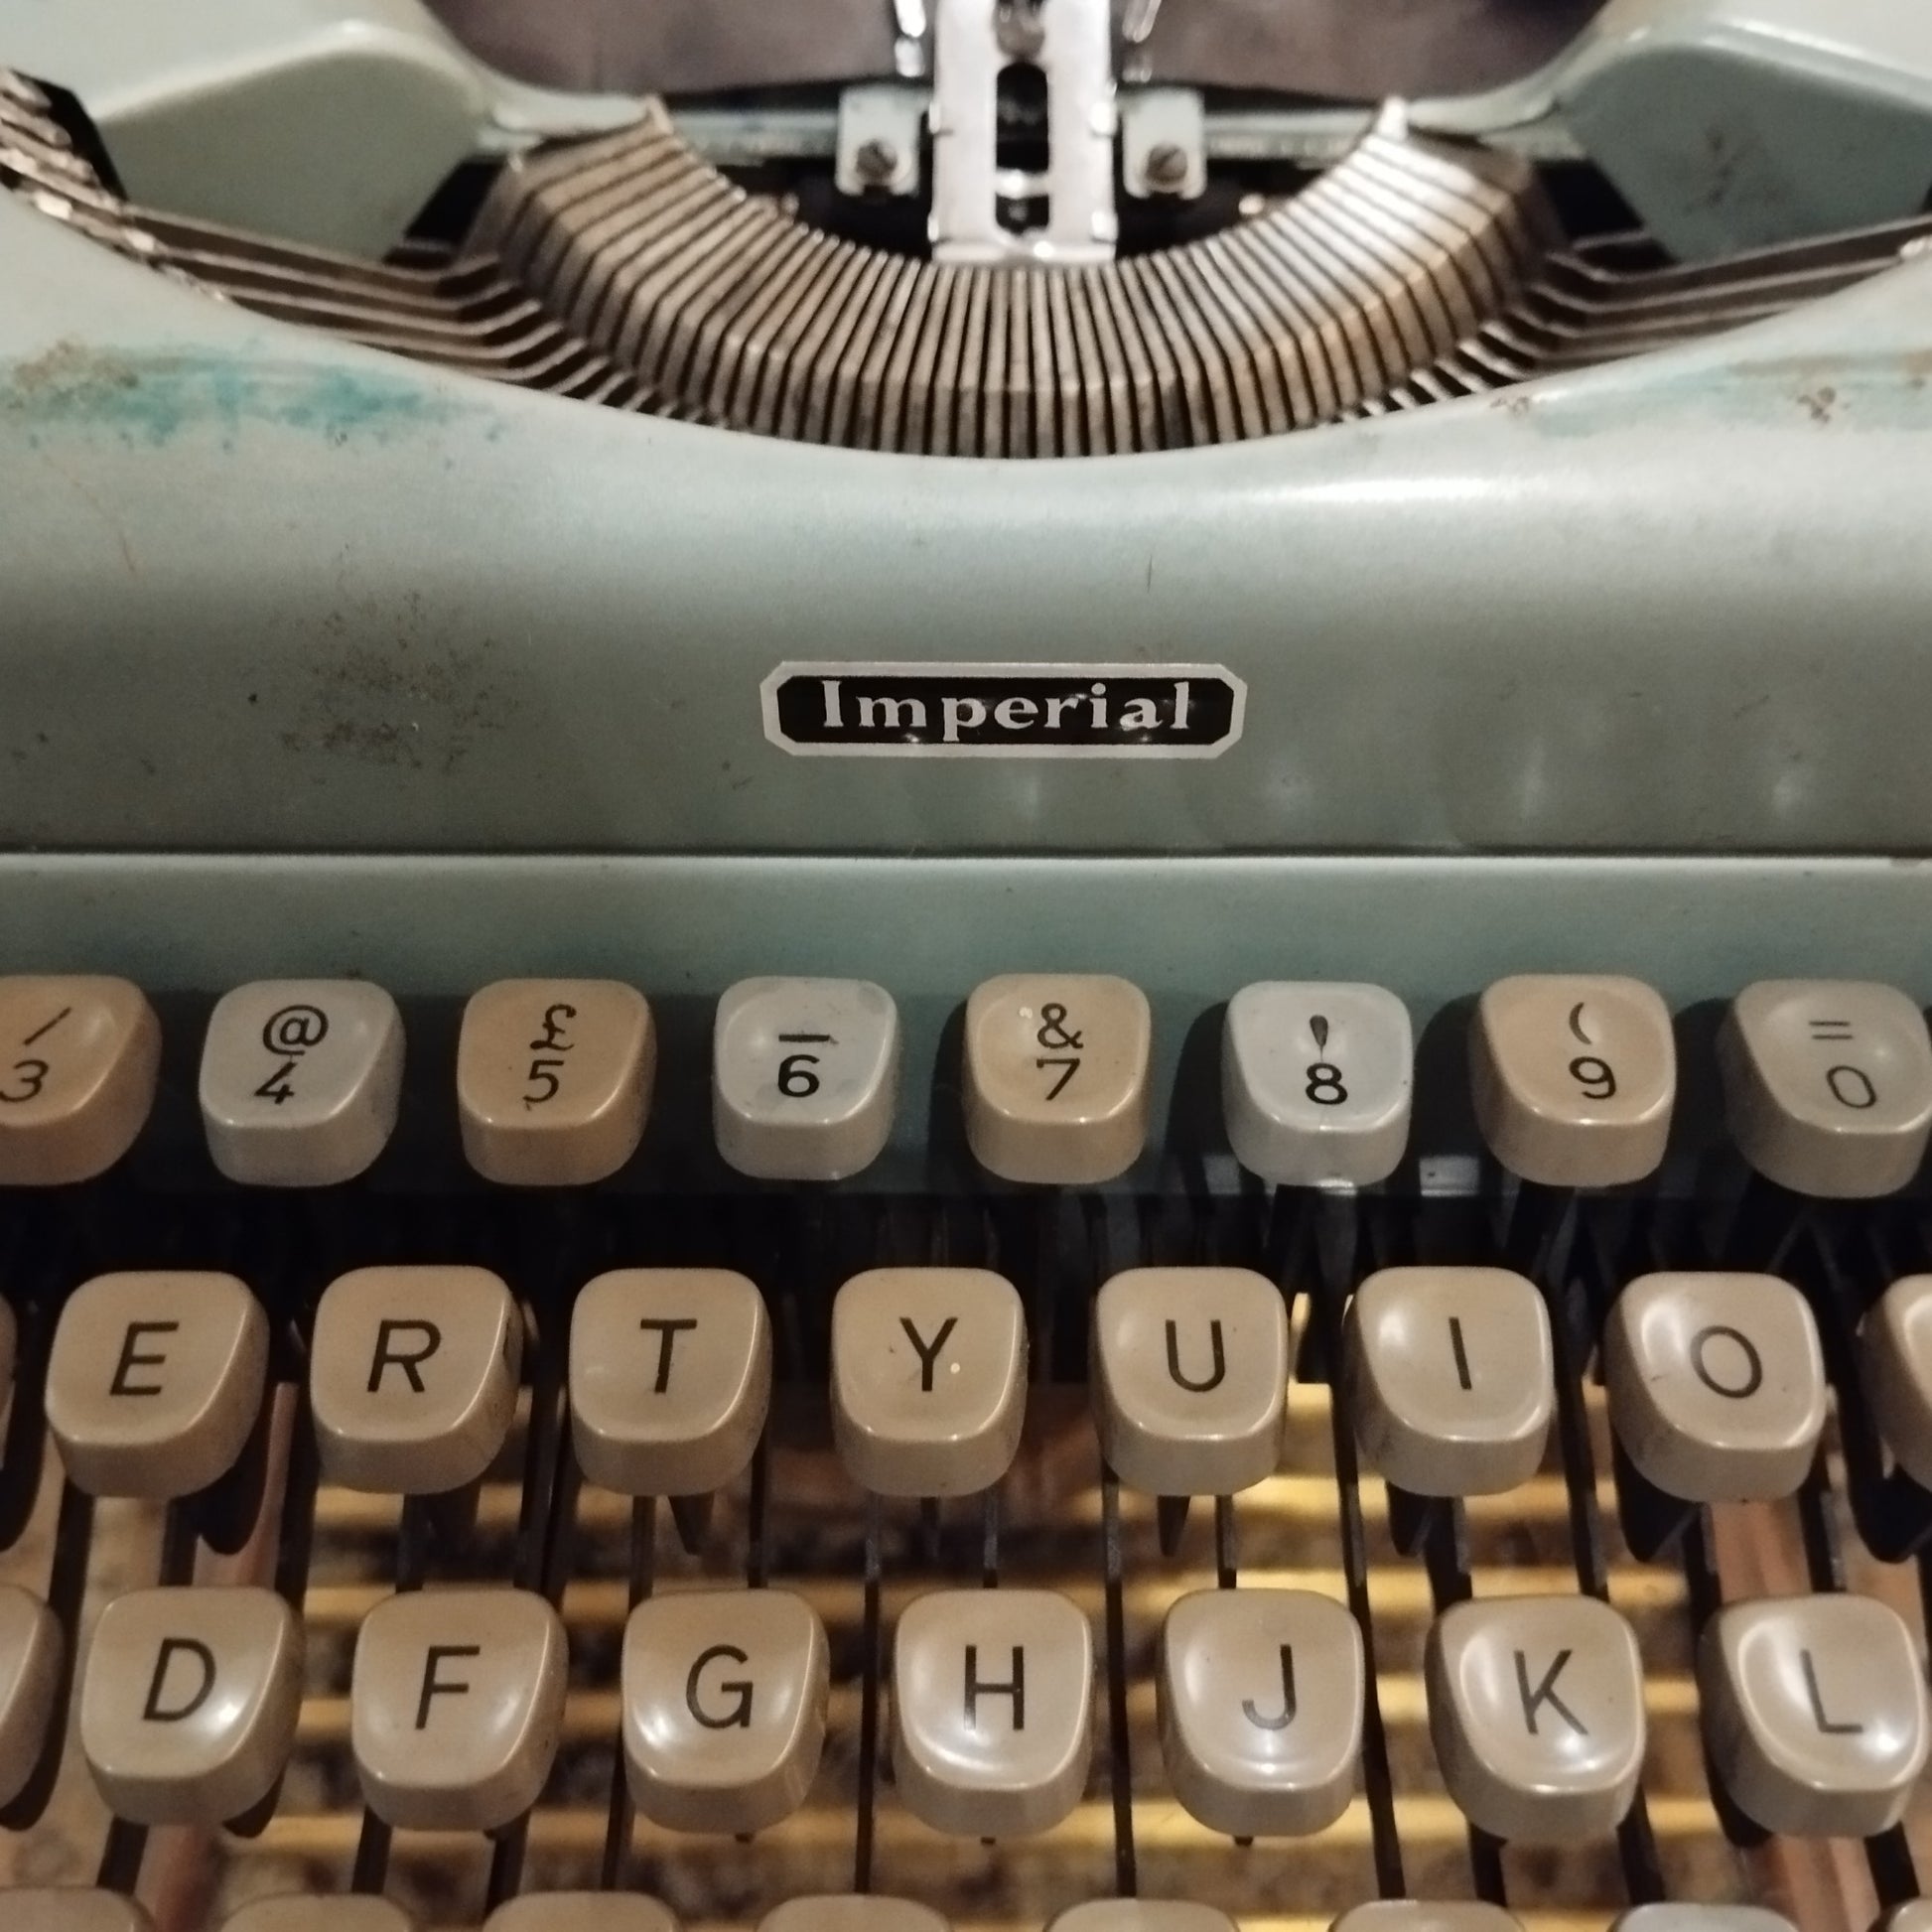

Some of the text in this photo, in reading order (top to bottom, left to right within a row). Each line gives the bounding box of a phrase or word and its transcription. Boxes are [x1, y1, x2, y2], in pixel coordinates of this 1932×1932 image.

[821, 679, 1189, 742] Imperial
[262, 1004, 328, 1055] @
[530, 1004, 577, 1050] £
[1036, 1003, 1083, 1049] &
[1570, 1002, 1591, 1044] (
[0, 1059, 50, 1102] 3
[254, 1062, 297, 1104] 4
[522, 1059, 565, 1110] 5
[777, 1054, 820, 1098] 6
[1035, 1058, 1080, 1101] 7
[1306, 1062, 1347, 1105] 8
[1569, 1056, 1617, 1099] 9
[1827, 1064, 1876, 1109] 0
[109, 1320, 180, 1396] E
[366, 1318, 442, 1393] R
[639, 1318, 697, 1394] T
[898, 1316, 958, 1393] Y
[1165, 1318, 1227, 1392] U
[1448, 1316, 1472, 1390] I
[1690, 1325, 1762, 1399] O
[141, 1637, 216, 1724] D
[414, 1645, 481, 1729] F
[685, 1645, 755, 1728] G
[964, 1645, 1025, 1730] H
[1241, 1644, 1296, 1730] J
[1514, 1649, 1588, 1735] K
[1799, 1648, 1863, 1735] L
